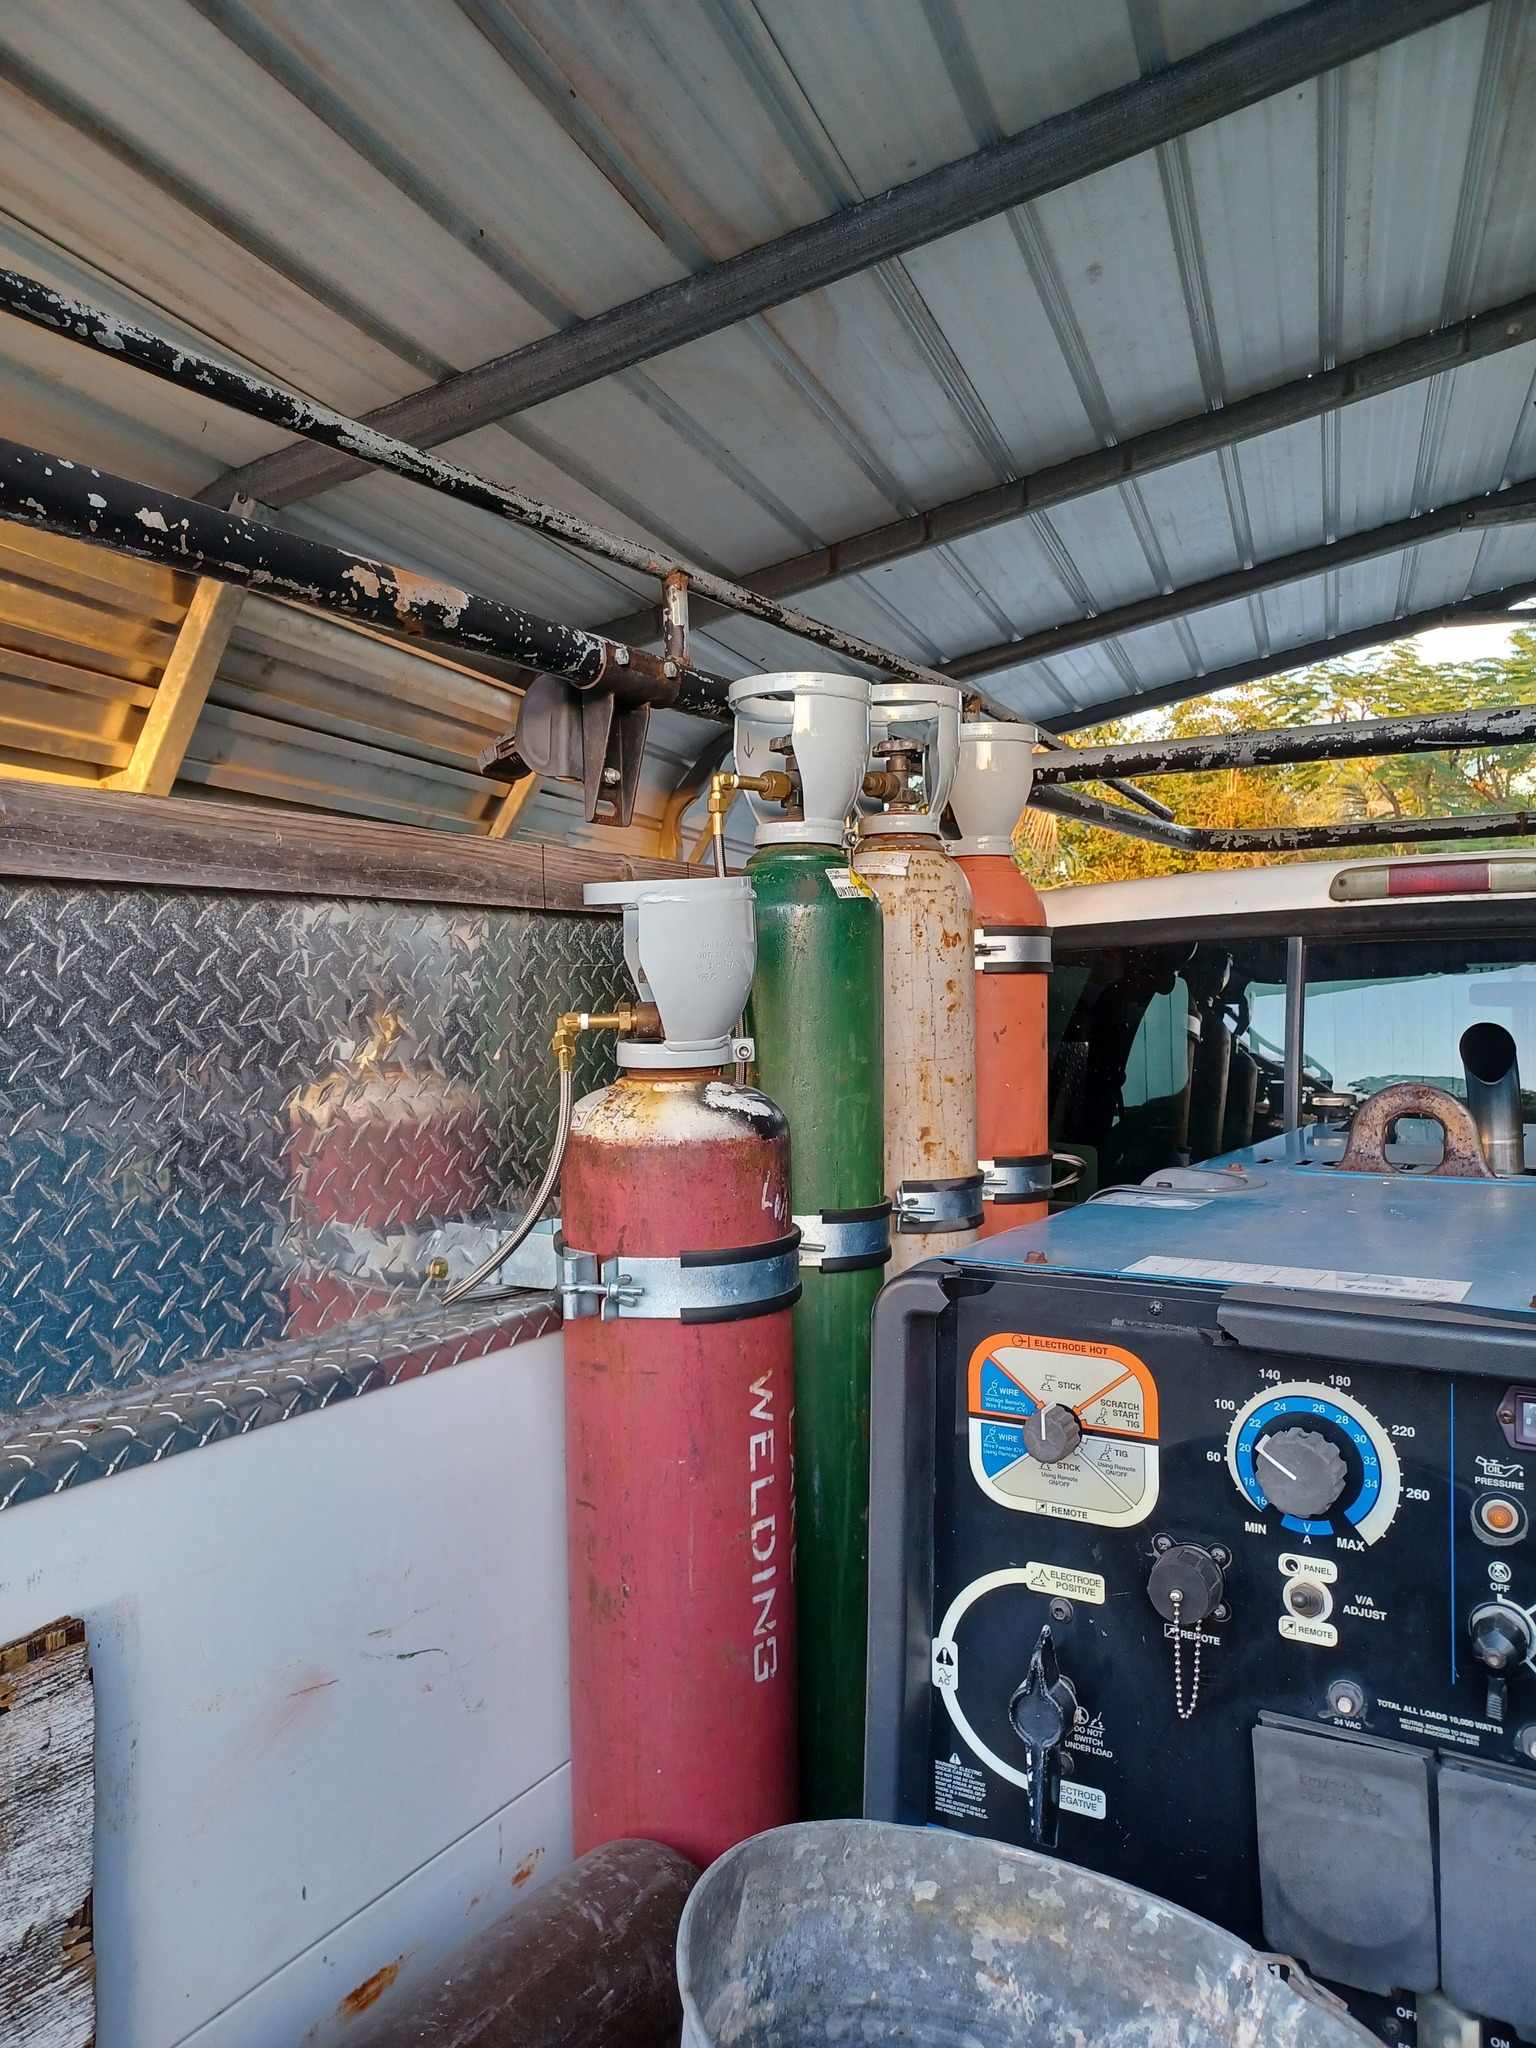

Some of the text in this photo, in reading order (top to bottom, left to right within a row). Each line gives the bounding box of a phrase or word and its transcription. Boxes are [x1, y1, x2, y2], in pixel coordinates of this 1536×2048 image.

[1034, 1339, 1109, 1355] ELECTRODE HOT
[1259, 1369, 1281, 1381] 140
[1057, 1381, 1082, 1391] STICK
[1329, 1375, 1351, 1387] 180
[999, 1387, 1020, 1397] WIRE
[1100, 1399, 1140, 1411] SCRATCH
[1214, 1399, 1235, 1411] 100
[1274, 1402, 1287, 1412] 24
[1312, 1403, 1326, 1414] 26
[1112, 1409, 1140, 1420] START
[1335, 1414, 1349, 1425] 28
[1126, 1420, 1140, 1428] TIG
[1249, 1418, 1262, 1428] 22
[1391, 1425, 1415, 1438] 220
[998, 1433, 1018, 1443] WIRE
[1353, 1434, 1367, 1445] 30
[1114, 1449, 1128, 1458] TIG
[1239, 1443, 1251, 1453] 20
[1206, 1451, 1221, 1462] 60
[1363, 1456, 1377, 1466] 32
[1057, 1461, 1081, 1472] STICK
[1098, 1461, 1136, 1472] Using Remote
[1487, 1465, 1503, 1475] OIL
[1057, 1474, 1078, 1482] Remote
[1106, 1470, 1128, 1478] ON/OFF
[1244, 1477, 1256, 1487] 18
[1365, 1479, 1378, 1489] 34
[1474, 1476, 1525, 1491] PRESSURE
[1405, 1488, 1430, 1501] 260
[1256, 1496, 1267, 1506] 16
[1051, 1506, 1088, 1520] REMOTE
[749, 1369, 778, 1683] WELDING
[1244, 1521, 1267, 1535] MIN
[1303, 1523, 1312, 1532] V
[1303, 1534, 1312, 1545] A
[1336, 1537, 1365, 1552] MAX
[1303, 1564, 1332, 1576] PANEL
[1050, 1570, 1101, 1588] ELECTRODE
[1056, 1581, 1096, 1597] POSITIVE
[1489, 1582, 1511, 1593] OFF
[1355, 1594, 1374, 1606] V/A
[1342, 1605, 1387, 1621] ADJUST
[1298, 1626, 1333, 1639] REMOTE
[937, 1676, 951, 1686] AC
[1376, 1699, 1504, 1735] TOTAL ALL LOADS 10,000 WATTS
[1334, 1718, 1362, 1730] 24 VAC
[1074, 1726, 1103, 1738] DO NOT
[1074, 1734, 1104, 1747] SWITCH
[1064, 1740, 1113, 1758] UNDER LOAD
[1060, 1785, 1103, 1803] ECTRODE
[1060, 1795, 1098, 1812] EGATIVE
[1490, 2037, 1510, 2048] ON
